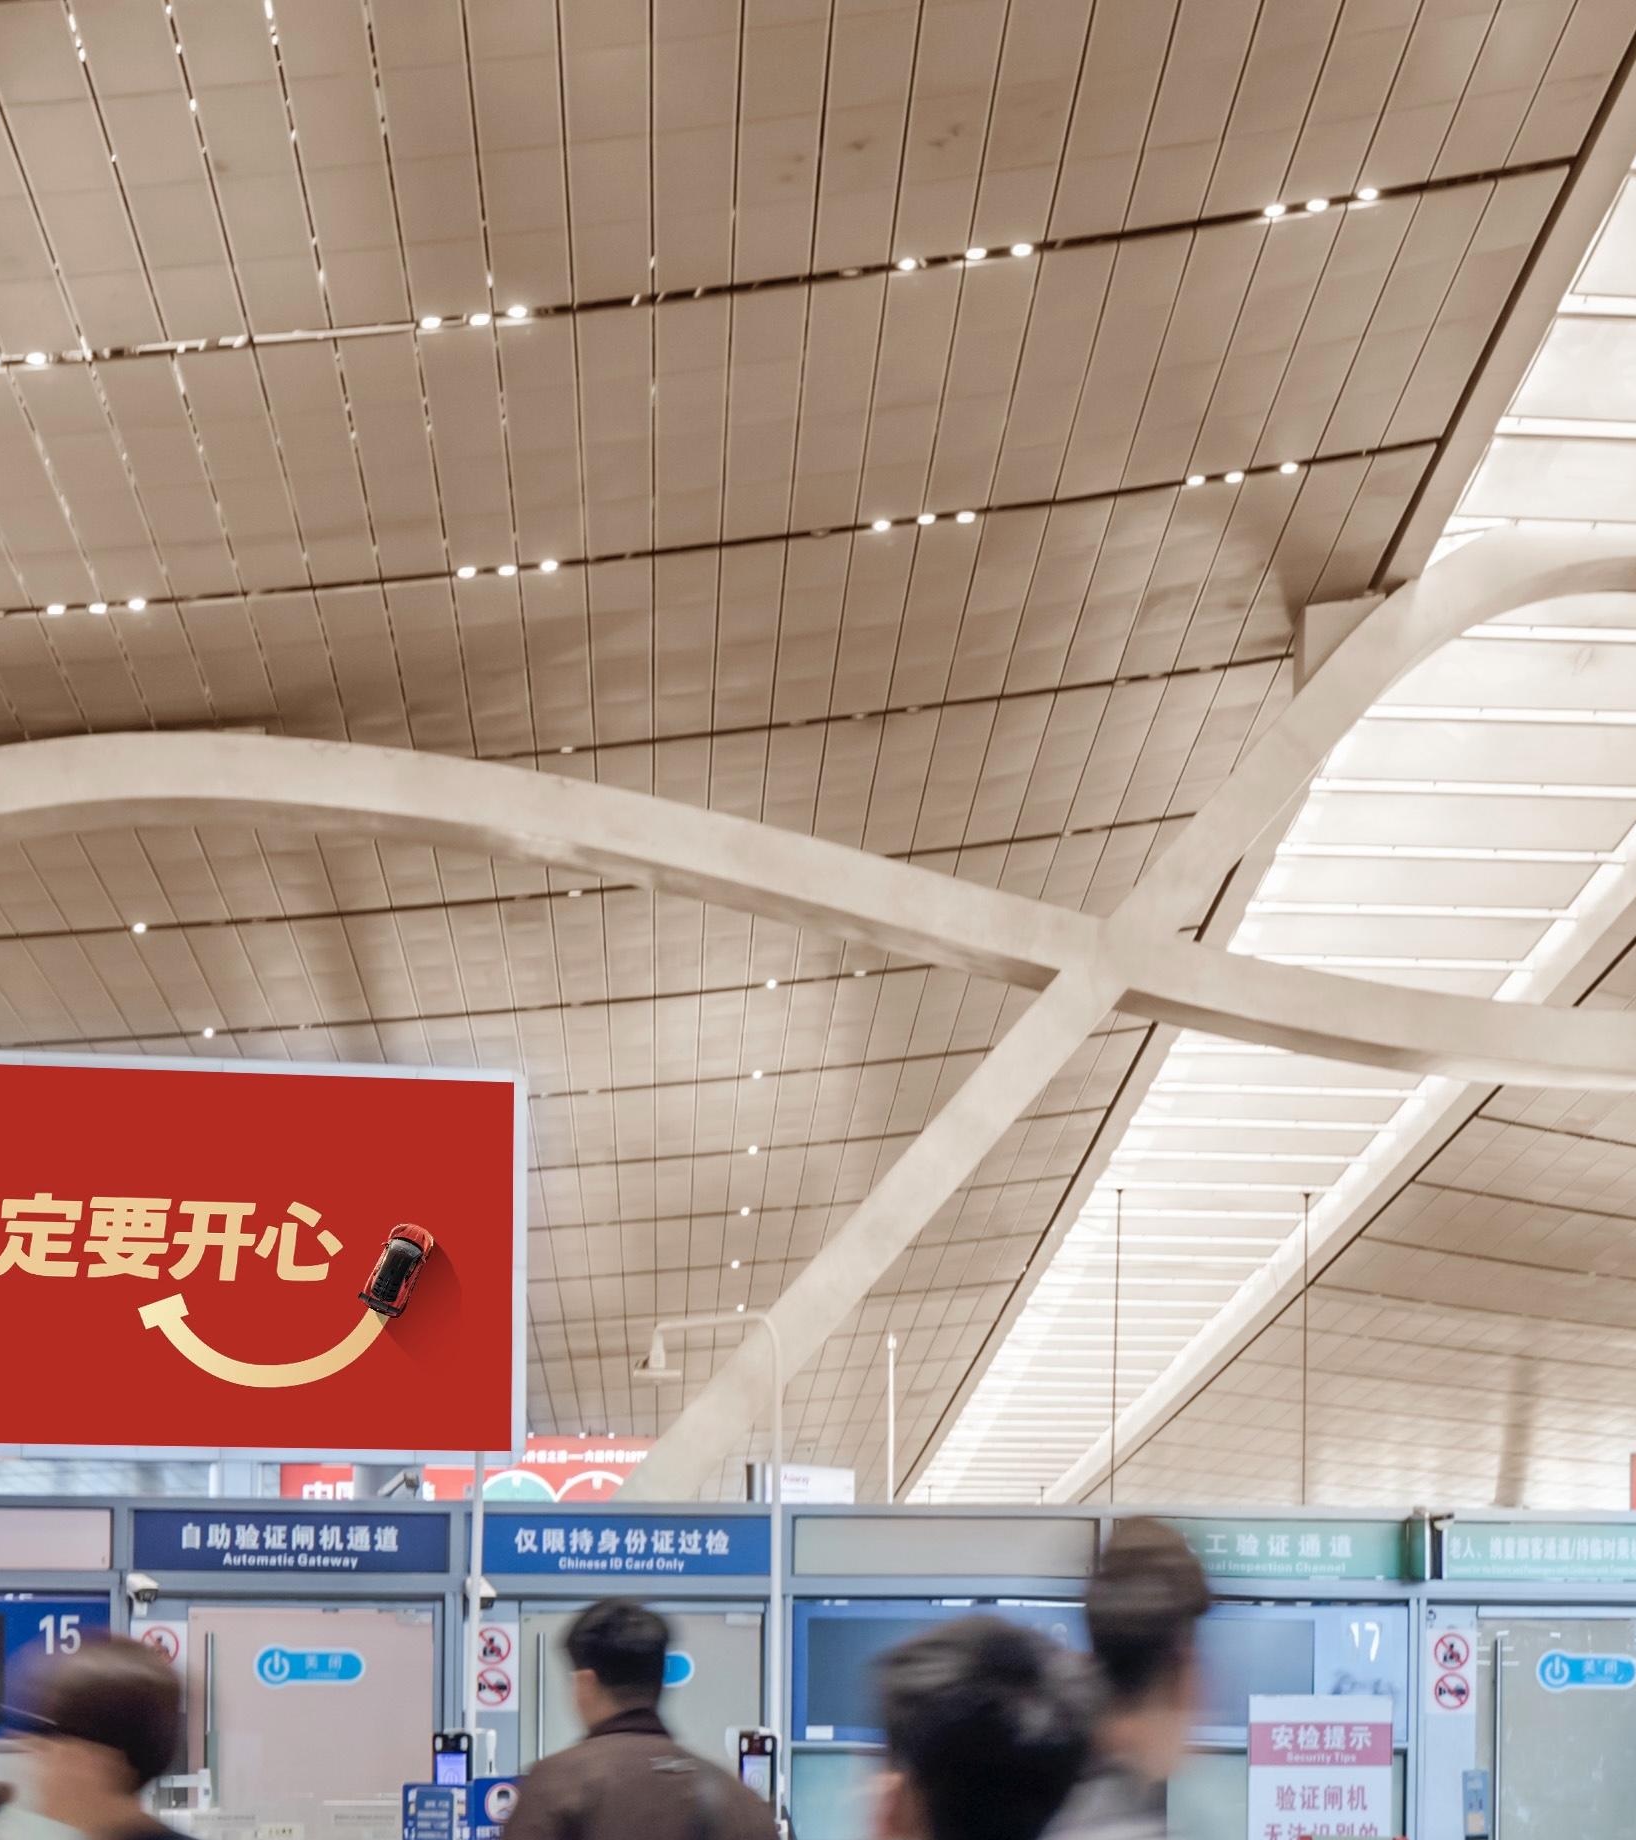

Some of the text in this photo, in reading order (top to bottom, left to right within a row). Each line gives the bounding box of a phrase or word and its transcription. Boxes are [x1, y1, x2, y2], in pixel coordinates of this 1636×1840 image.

[181, 1523, 399, 1552] 自助验证闸机通道
[514, 1528, 730, 1555] 仅限持身份证过检
[223, 1554, 358, 1571] Automatic Gateway
[559, 1557, 685, 1573] Chinese ID Card Only
[1228, 1561, 1292, 1574] Inspection
[1295, 1562, 1346, 1575] Channel
[39, 1615, 82, 1655] 15
[1349, 1621, 1381, 1662] 17
[1271, 1724, 1373, 1751] 安检提示
[1286, 1752, 1357, 1766] Security Tips
[1275, 1784, 1369, 1812] 验证闸机
